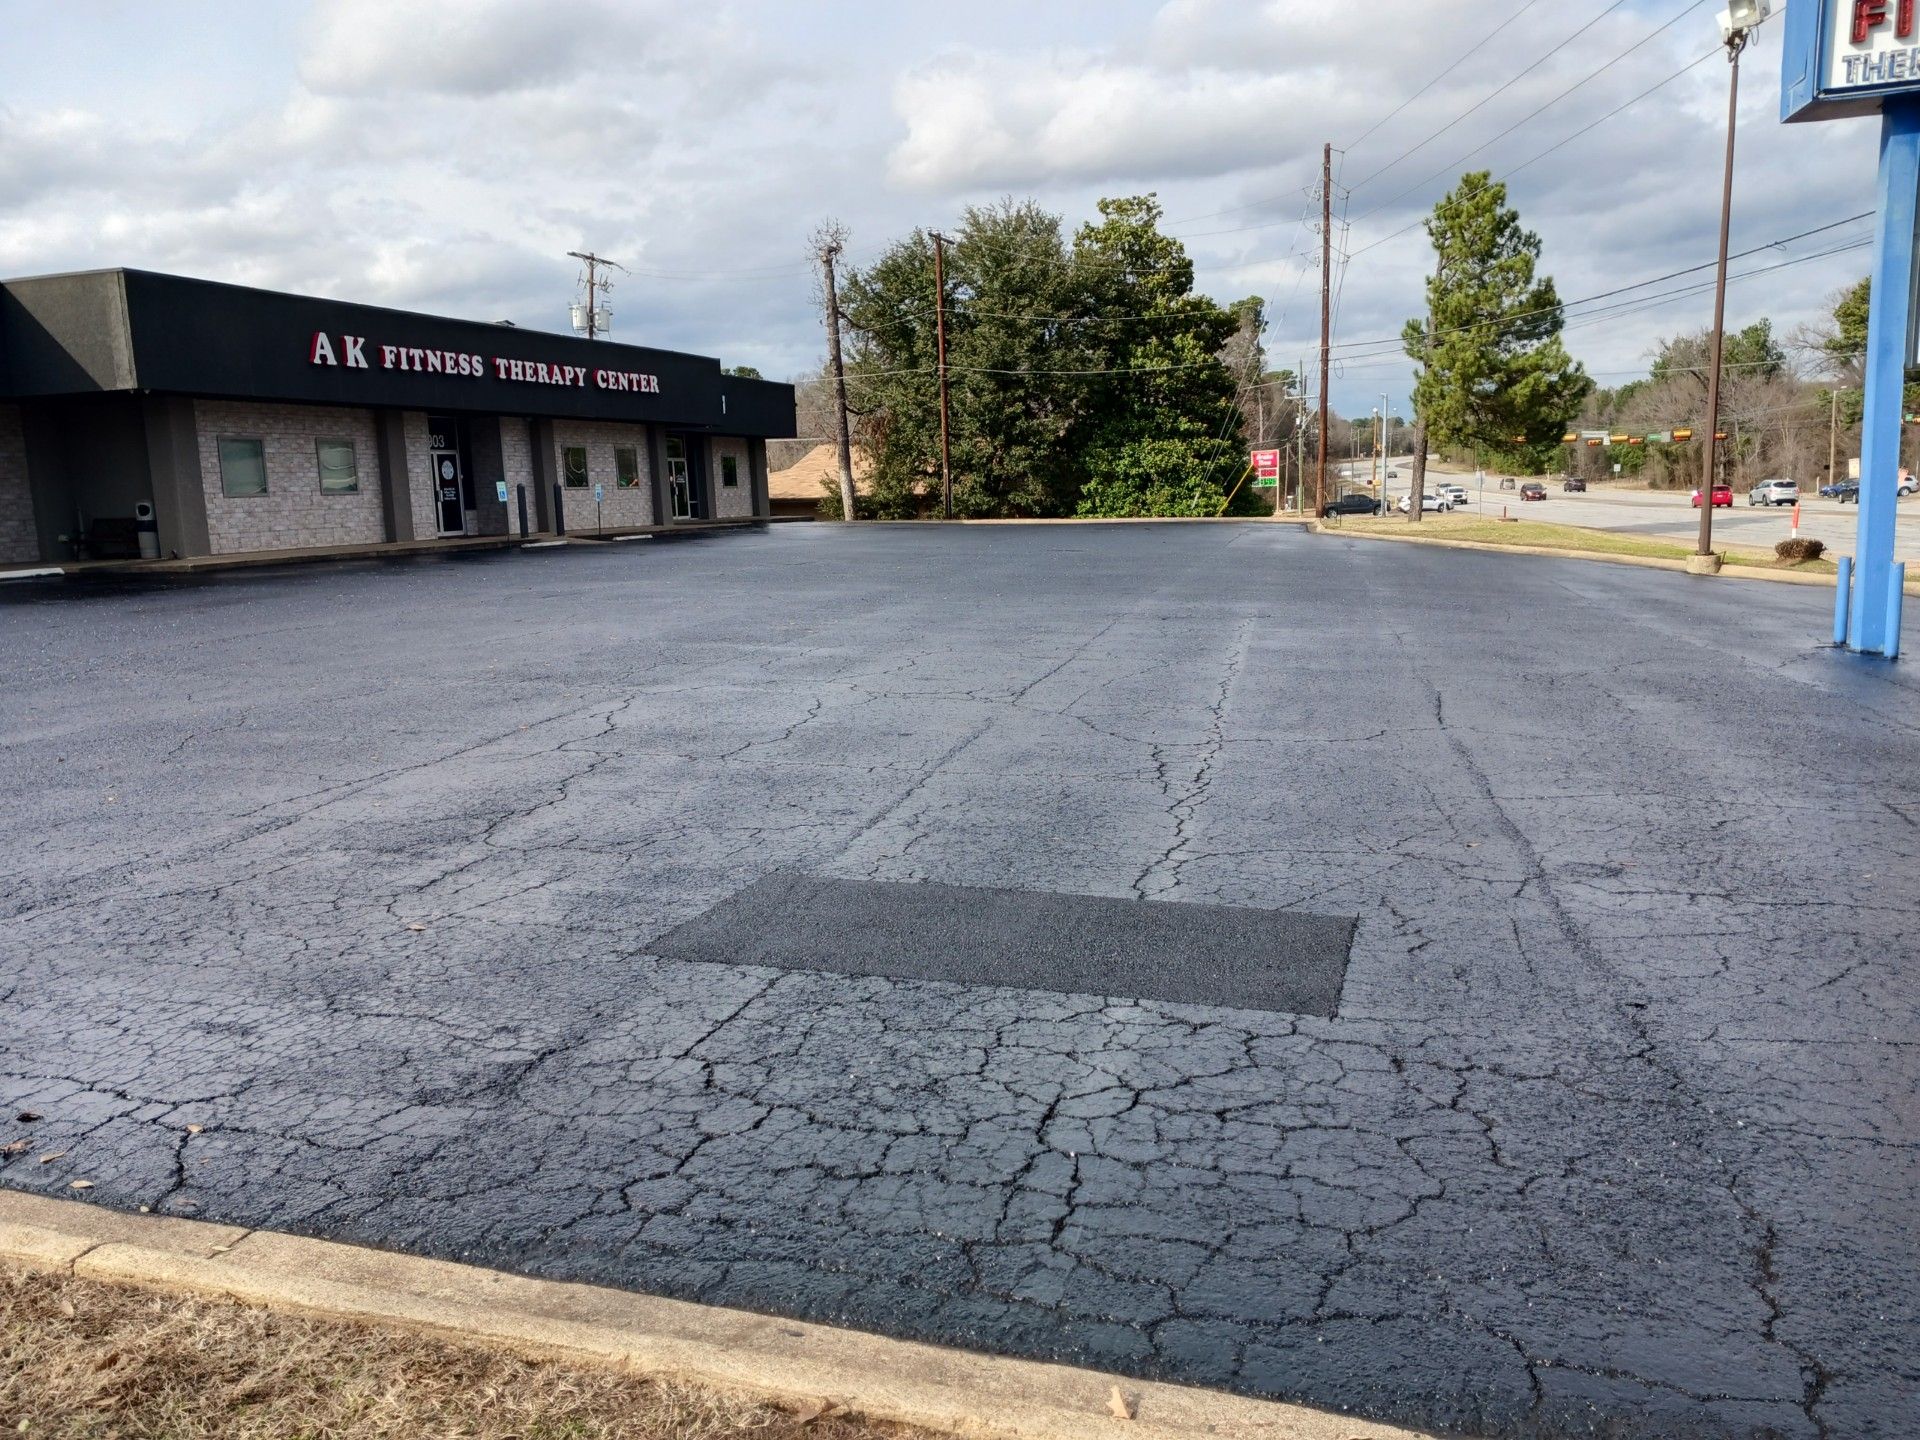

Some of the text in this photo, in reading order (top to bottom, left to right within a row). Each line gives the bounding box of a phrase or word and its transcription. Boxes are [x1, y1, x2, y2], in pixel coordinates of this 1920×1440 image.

[380, 344, 484, 377] FITNESS
[495, 357, 587, 388] THERAPY
[596, 369, 660, 394] CENTER
